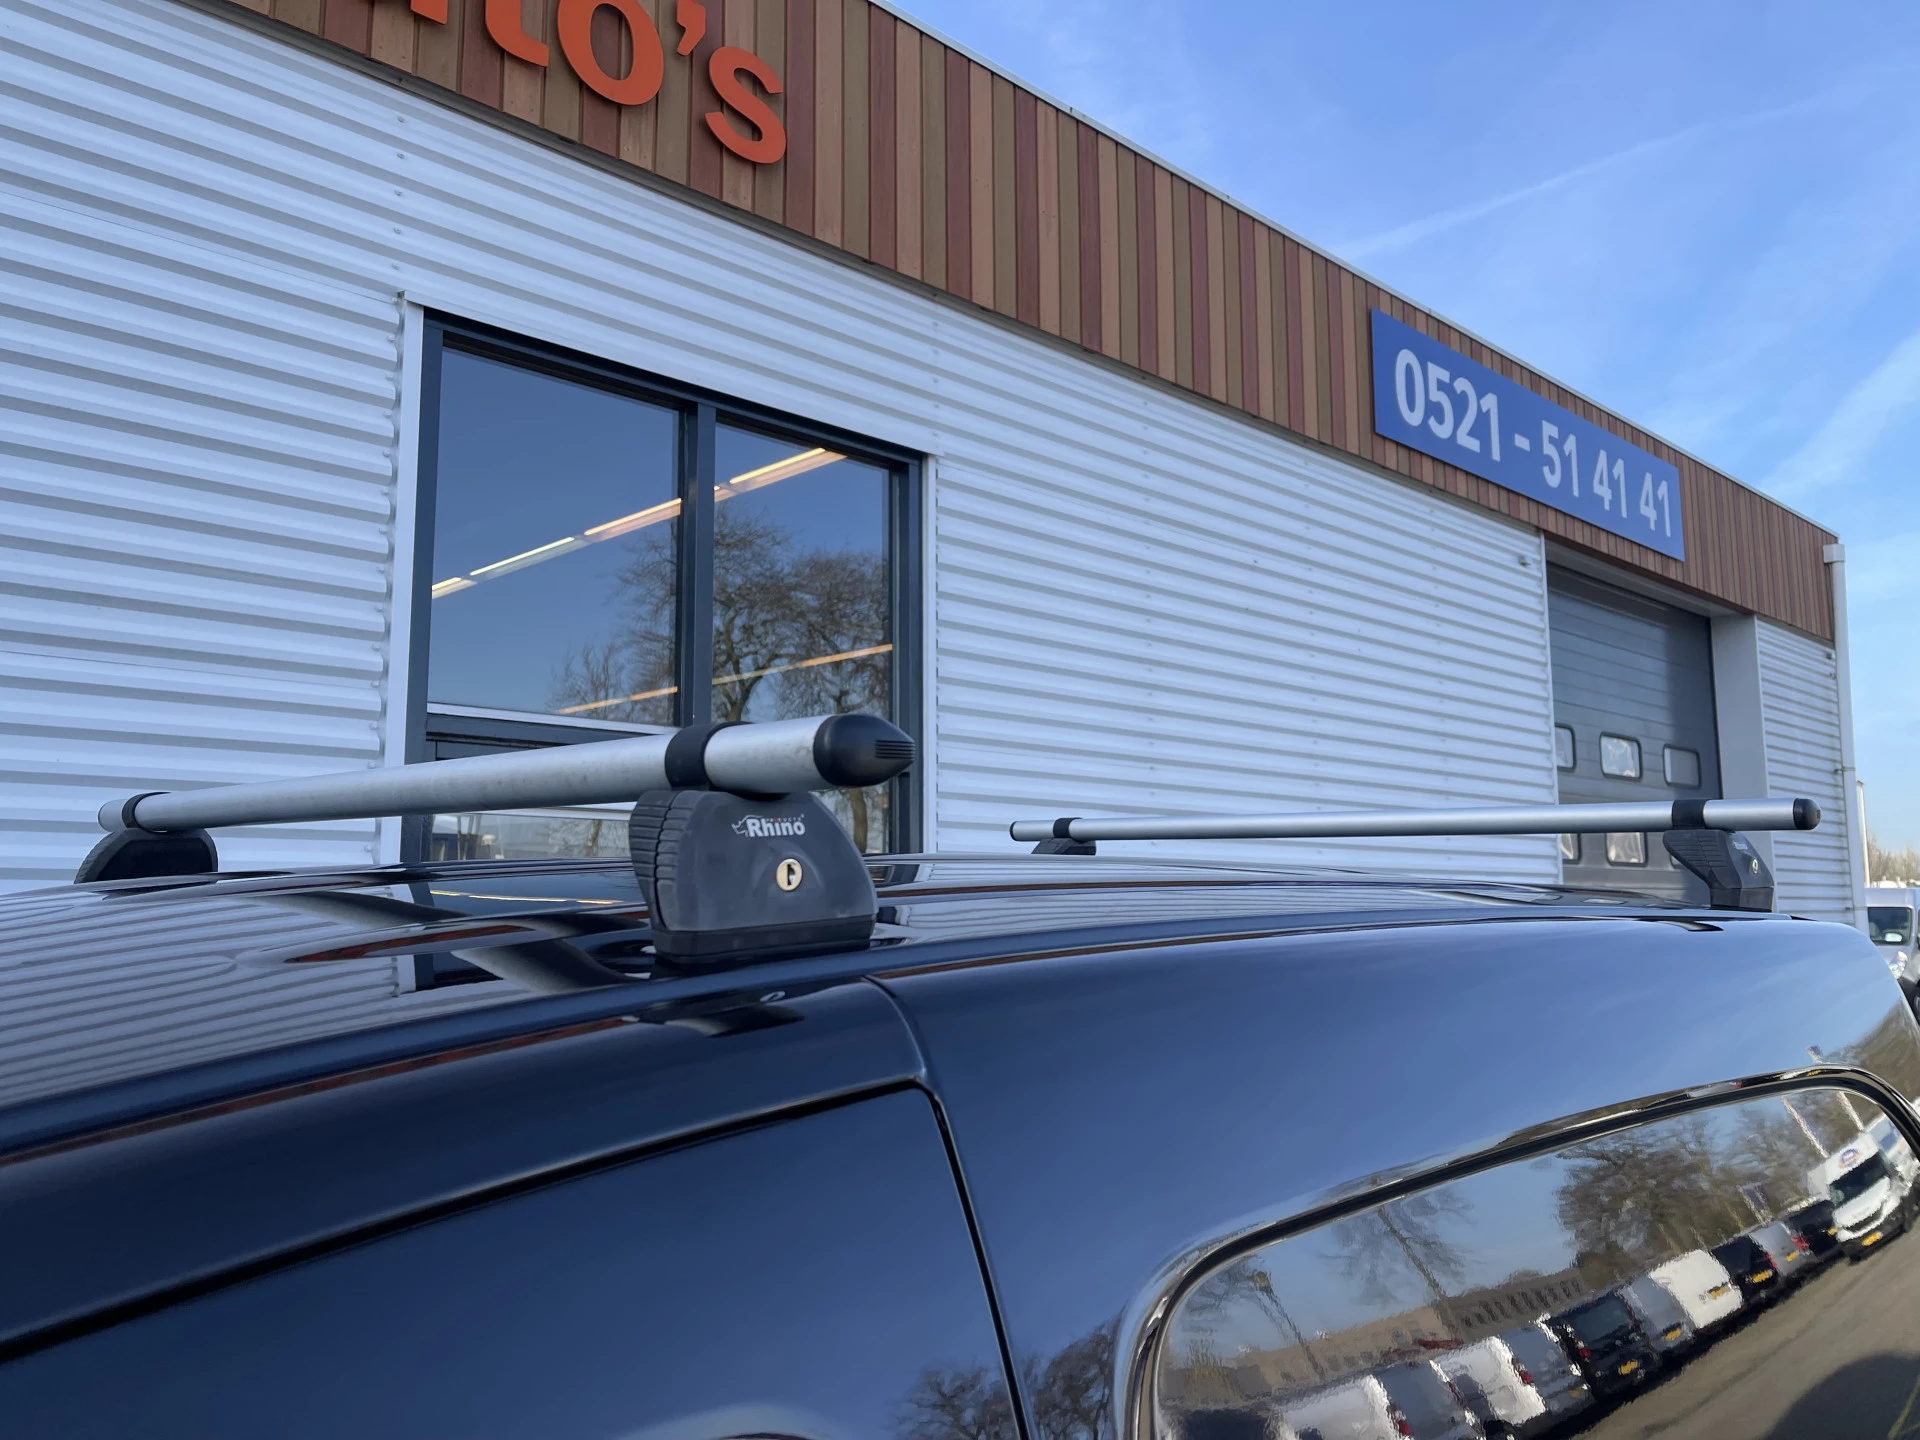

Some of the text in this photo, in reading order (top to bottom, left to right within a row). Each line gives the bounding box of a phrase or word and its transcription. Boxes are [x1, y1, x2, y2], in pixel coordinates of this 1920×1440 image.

[1395, 349, 1501, 462] 0521
[1542, 420, 1580, 498] 51
[1593, 449, 1628, 519] 41
[1639, 472, 1672, 538] 41
[746, 818, 806, 837] Rhino
